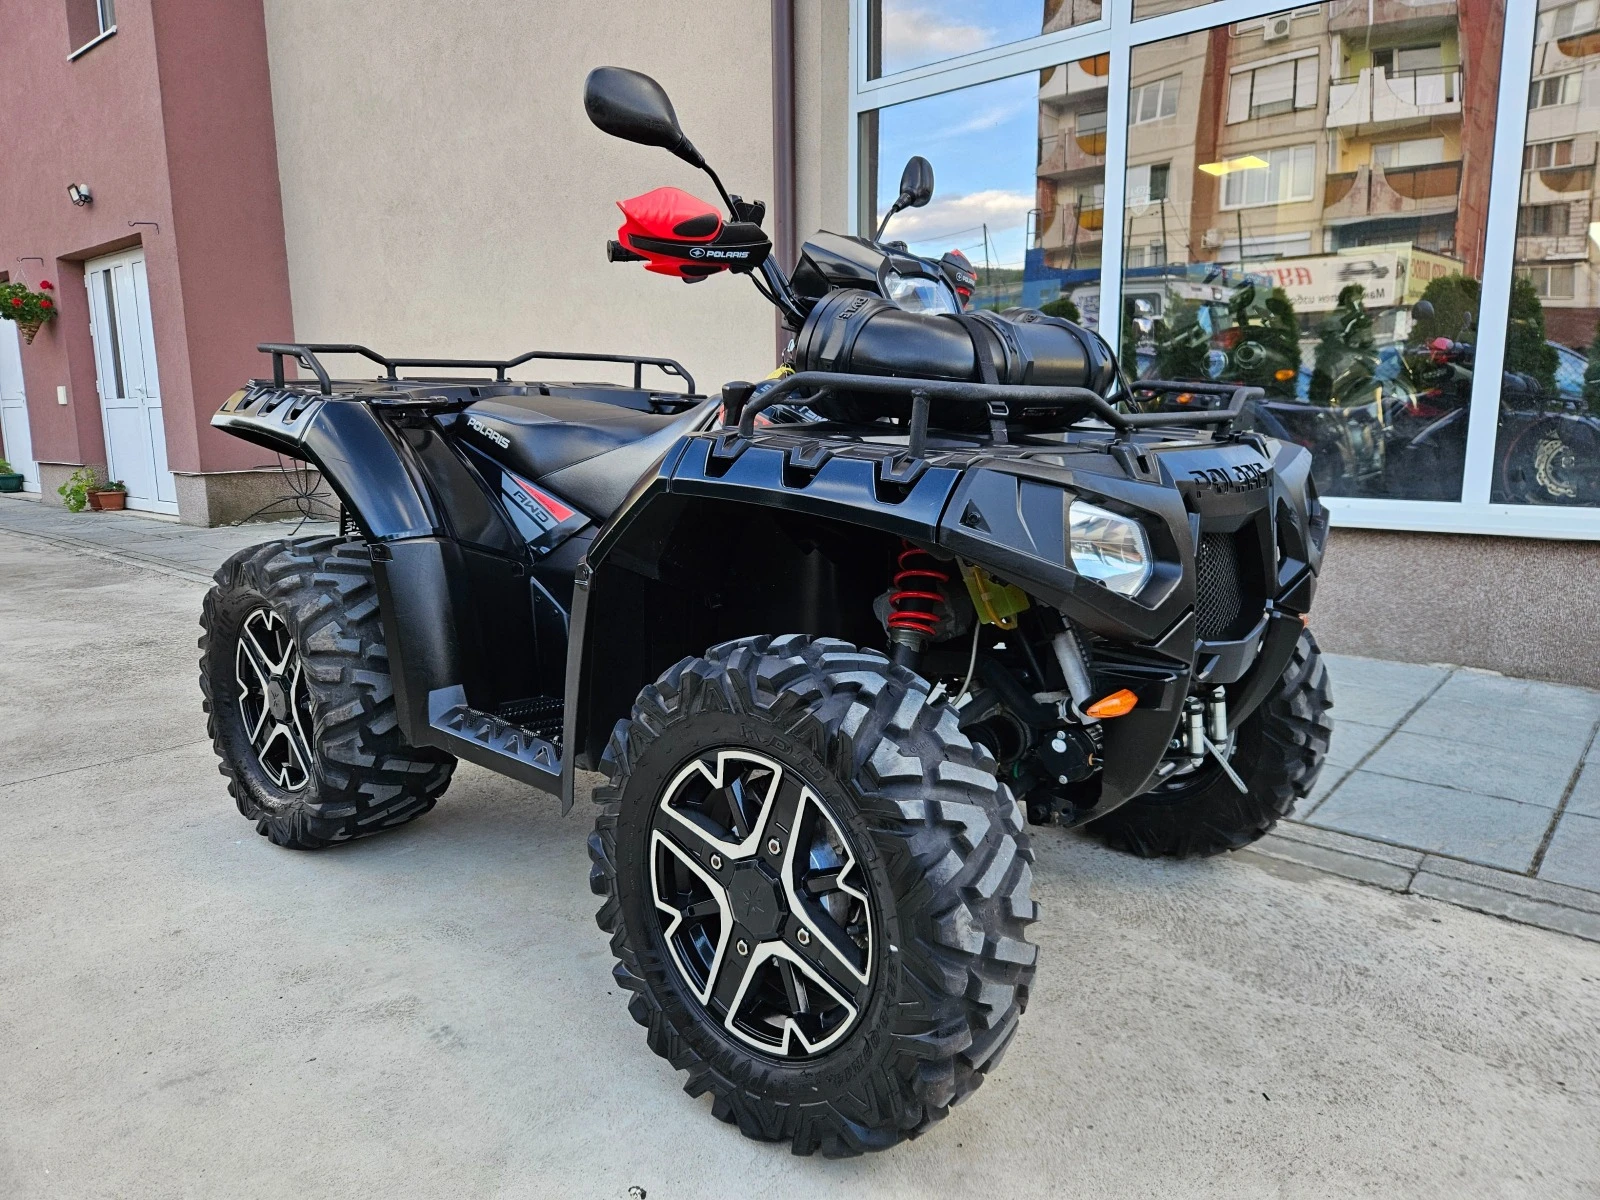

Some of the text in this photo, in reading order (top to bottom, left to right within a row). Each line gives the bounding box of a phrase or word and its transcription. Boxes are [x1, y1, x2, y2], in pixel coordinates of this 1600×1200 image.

[706, 250, 750, 258] POLARIS
[467, 417, 510, 449] POLARIS
[1188, 462, 1268, 498] POLARIS
[513, 490, 549, 522] AWD
